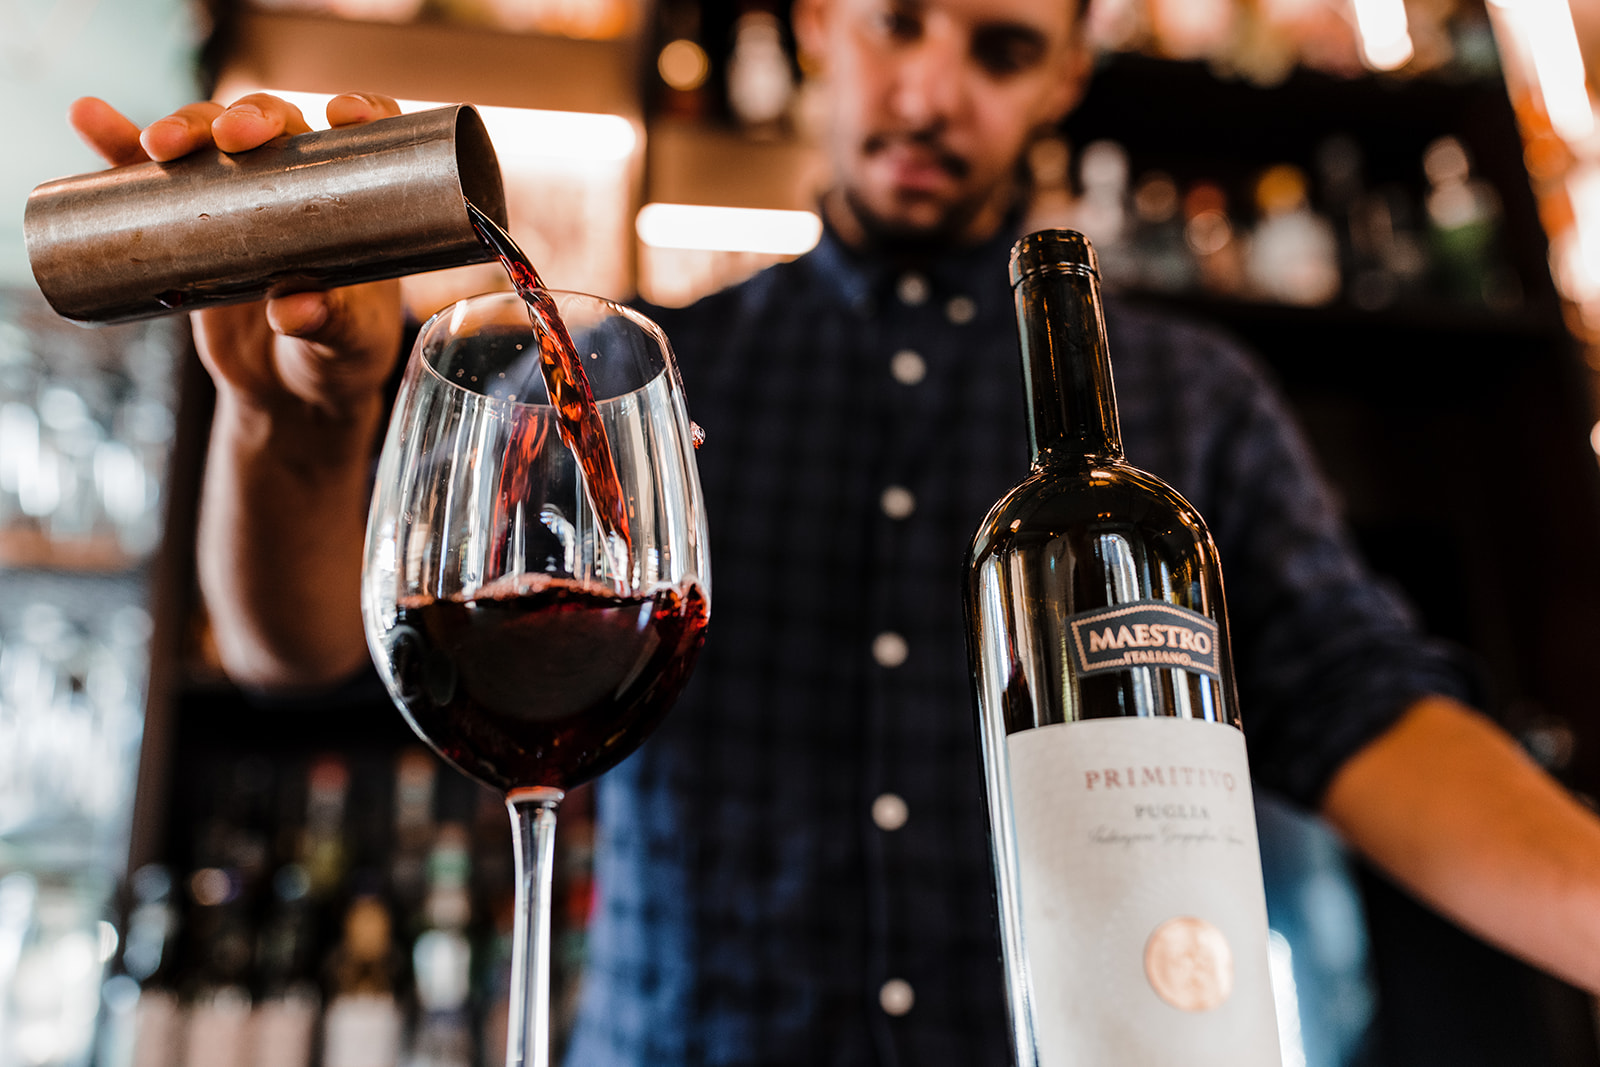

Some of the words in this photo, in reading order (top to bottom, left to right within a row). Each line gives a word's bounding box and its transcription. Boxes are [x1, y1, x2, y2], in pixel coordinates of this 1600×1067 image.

[1089, 623, 1212, 655] MAESTRO
[1123, 650, 1192, 666] ITALIANO
[1085, 766, 1235, 791] PRIMITIVO
[1134, 803, 1210, 820] PUGLIA
